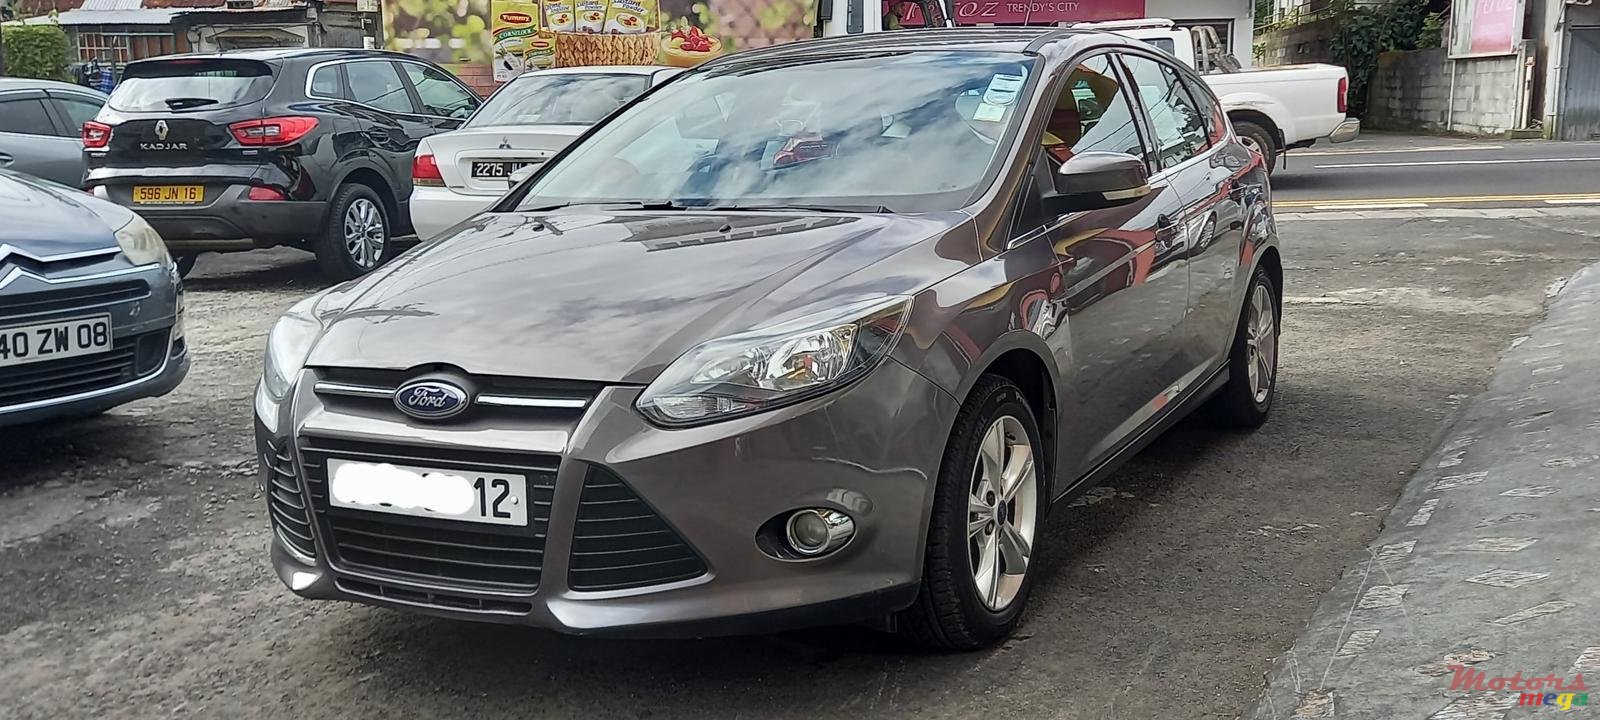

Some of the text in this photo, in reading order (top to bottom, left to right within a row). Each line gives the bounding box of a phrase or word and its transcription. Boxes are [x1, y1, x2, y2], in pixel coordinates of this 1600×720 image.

[622, 4, 645, 13] Powder
[1006, 3, 1055, 12] TRENDY'S
[1057, 2, 1080, 12] CITY
[476, 163, 504, 176] 2275
[140, 187, 197, 200] 596 JN 16
[36, 326, 69, 355] ZW
[77, 322, 107, 349] 08
[408, 387, 446, 408] Ford
[473, 477, 511, 519] 12
